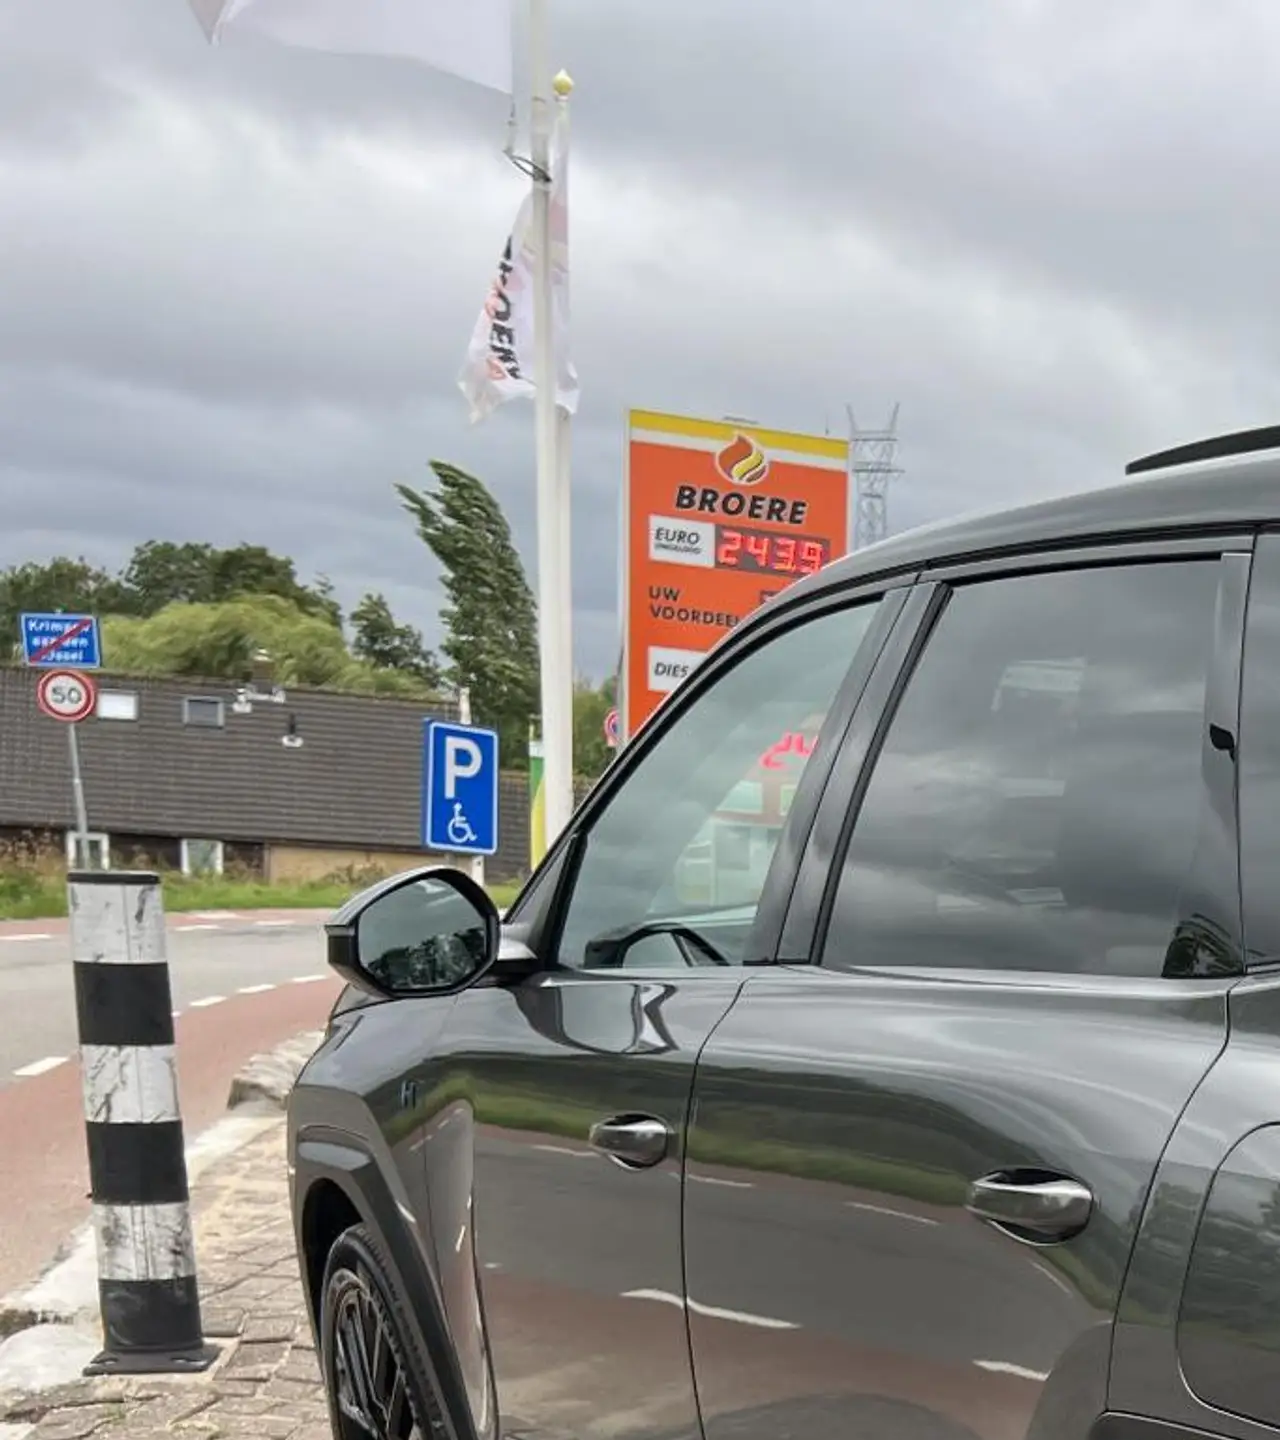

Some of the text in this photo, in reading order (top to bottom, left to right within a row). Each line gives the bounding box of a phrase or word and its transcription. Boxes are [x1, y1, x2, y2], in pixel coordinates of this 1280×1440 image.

[675, 485, 807, 525] BROERE
[655, 527, 701, 545] EURO
[648, 585, 681, 603] UW
[51, 686, 82, 704] 50
[444, 736, 483, 799] P
